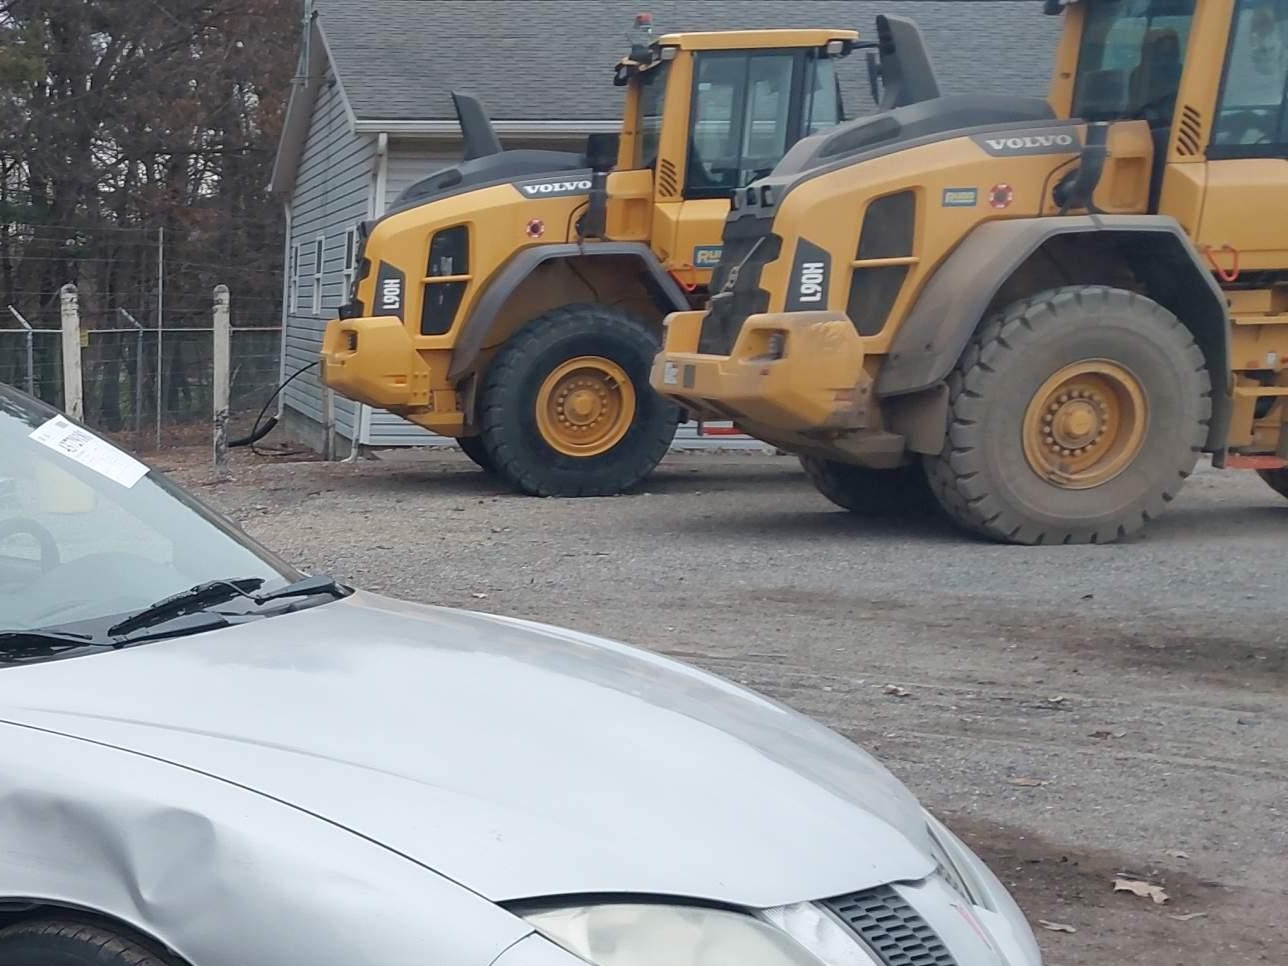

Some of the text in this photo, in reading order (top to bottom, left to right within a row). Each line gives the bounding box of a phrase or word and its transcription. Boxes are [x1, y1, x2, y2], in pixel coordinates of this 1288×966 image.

[986, 134, 1073, 150] VOLVO
[523, 180, 592, 194] VOLVO
[382, 278, 401, 309] L90H
[799, 262, 824, 302] L90H
